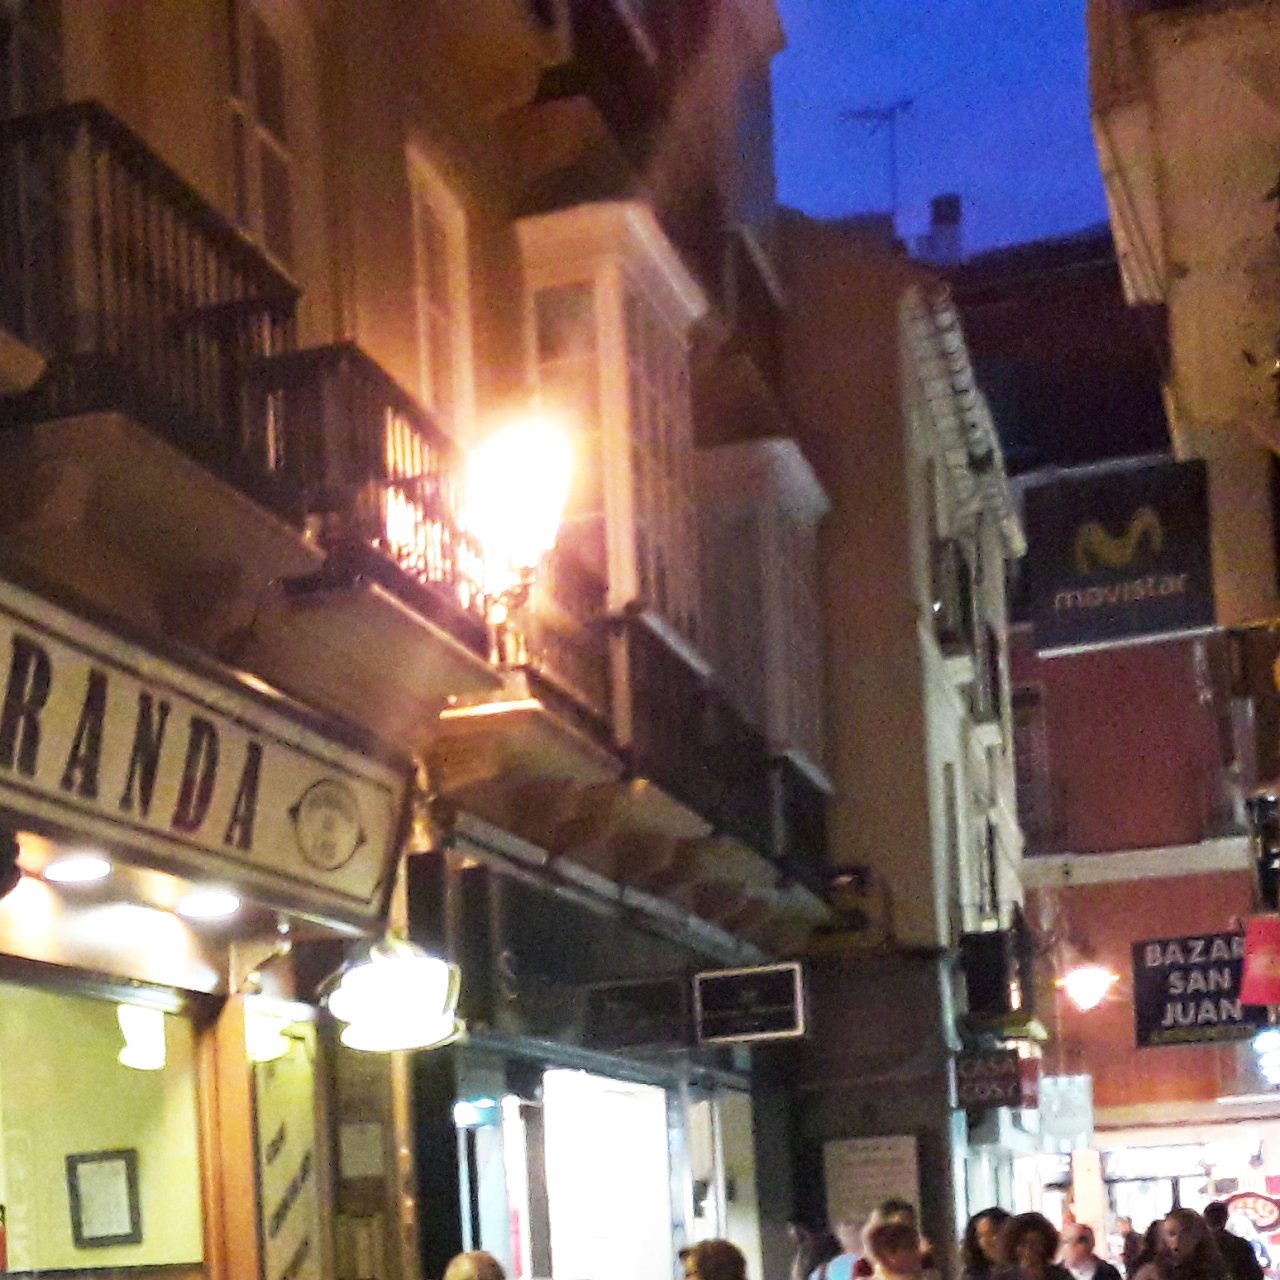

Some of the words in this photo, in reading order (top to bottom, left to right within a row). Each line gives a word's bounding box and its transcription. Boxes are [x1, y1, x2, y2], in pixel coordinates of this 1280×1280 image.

[1054, 573, 1188, 610] movistar
[1168, 967, 1233, 995] SAN
[1161, 998, 1243, 1027] JUAN
